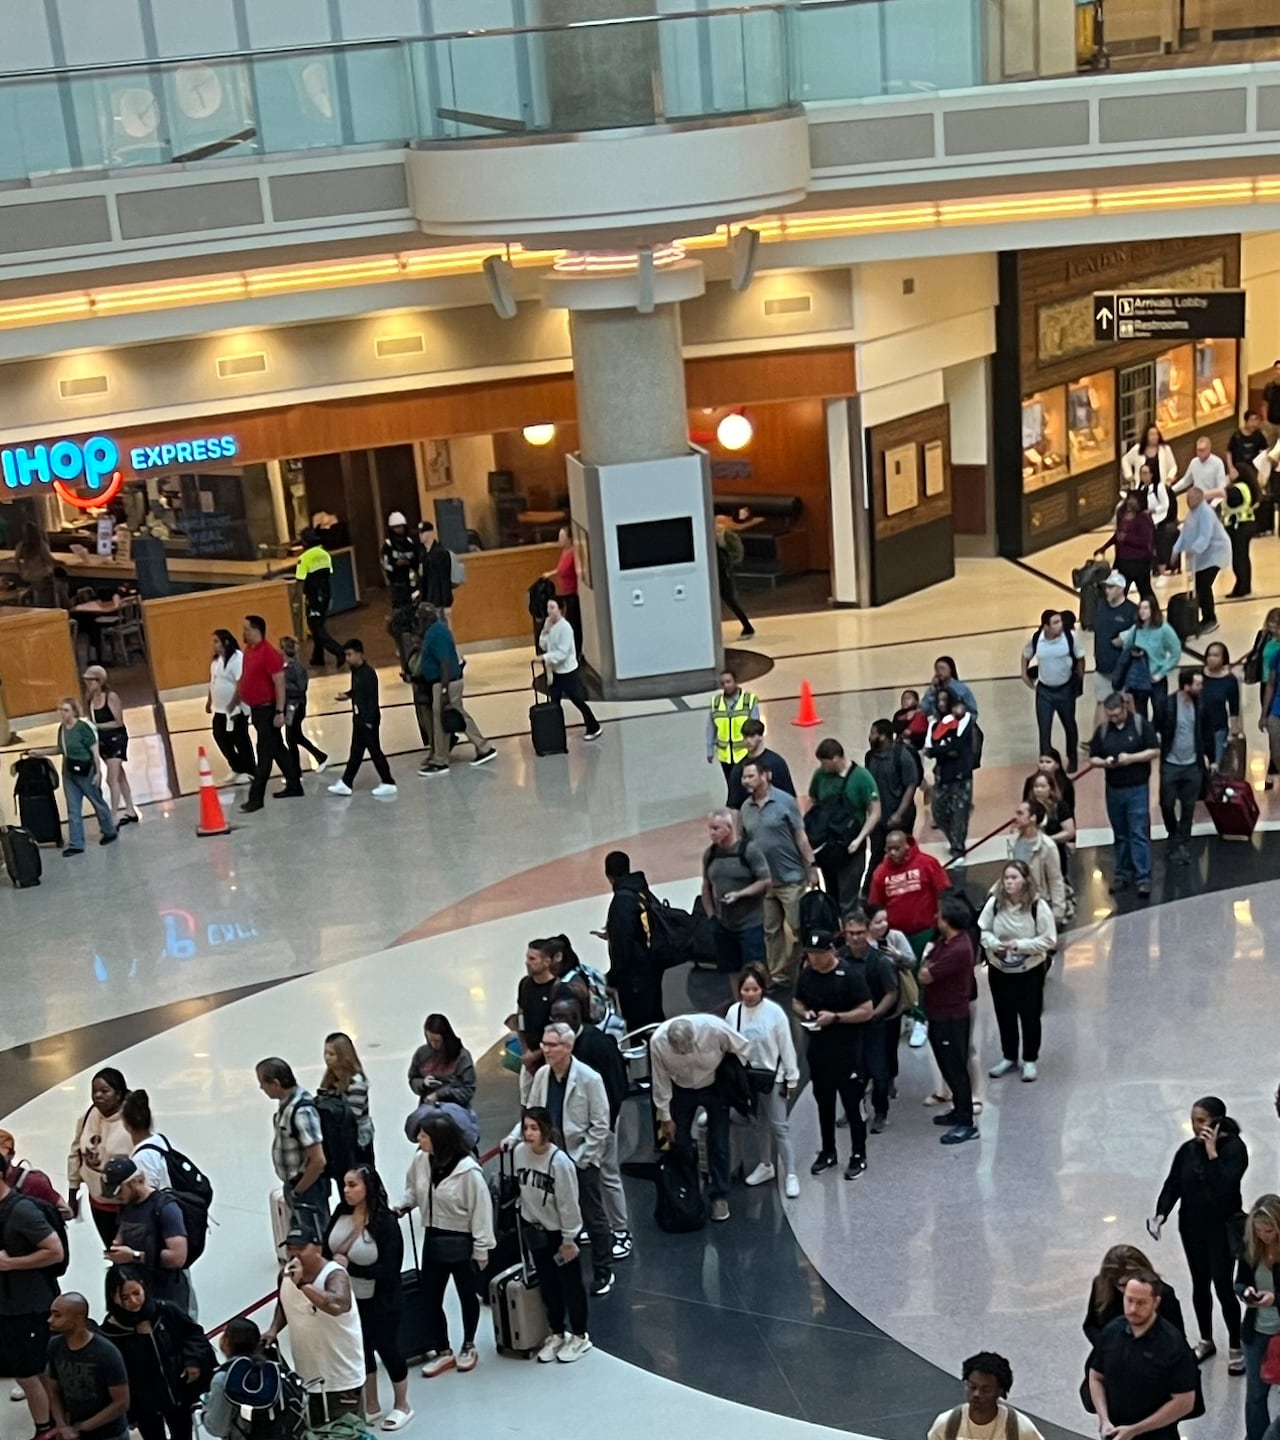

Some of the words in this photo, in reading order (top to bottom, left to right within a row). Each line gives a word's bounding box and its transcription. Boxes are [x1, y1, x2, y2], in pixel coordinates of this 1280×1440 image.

[1134, 297, 1173, 308] Arrivals
[1134, 319, 1190, 331] Restrooms
[130, 435, 237, 470] EXPRESS
